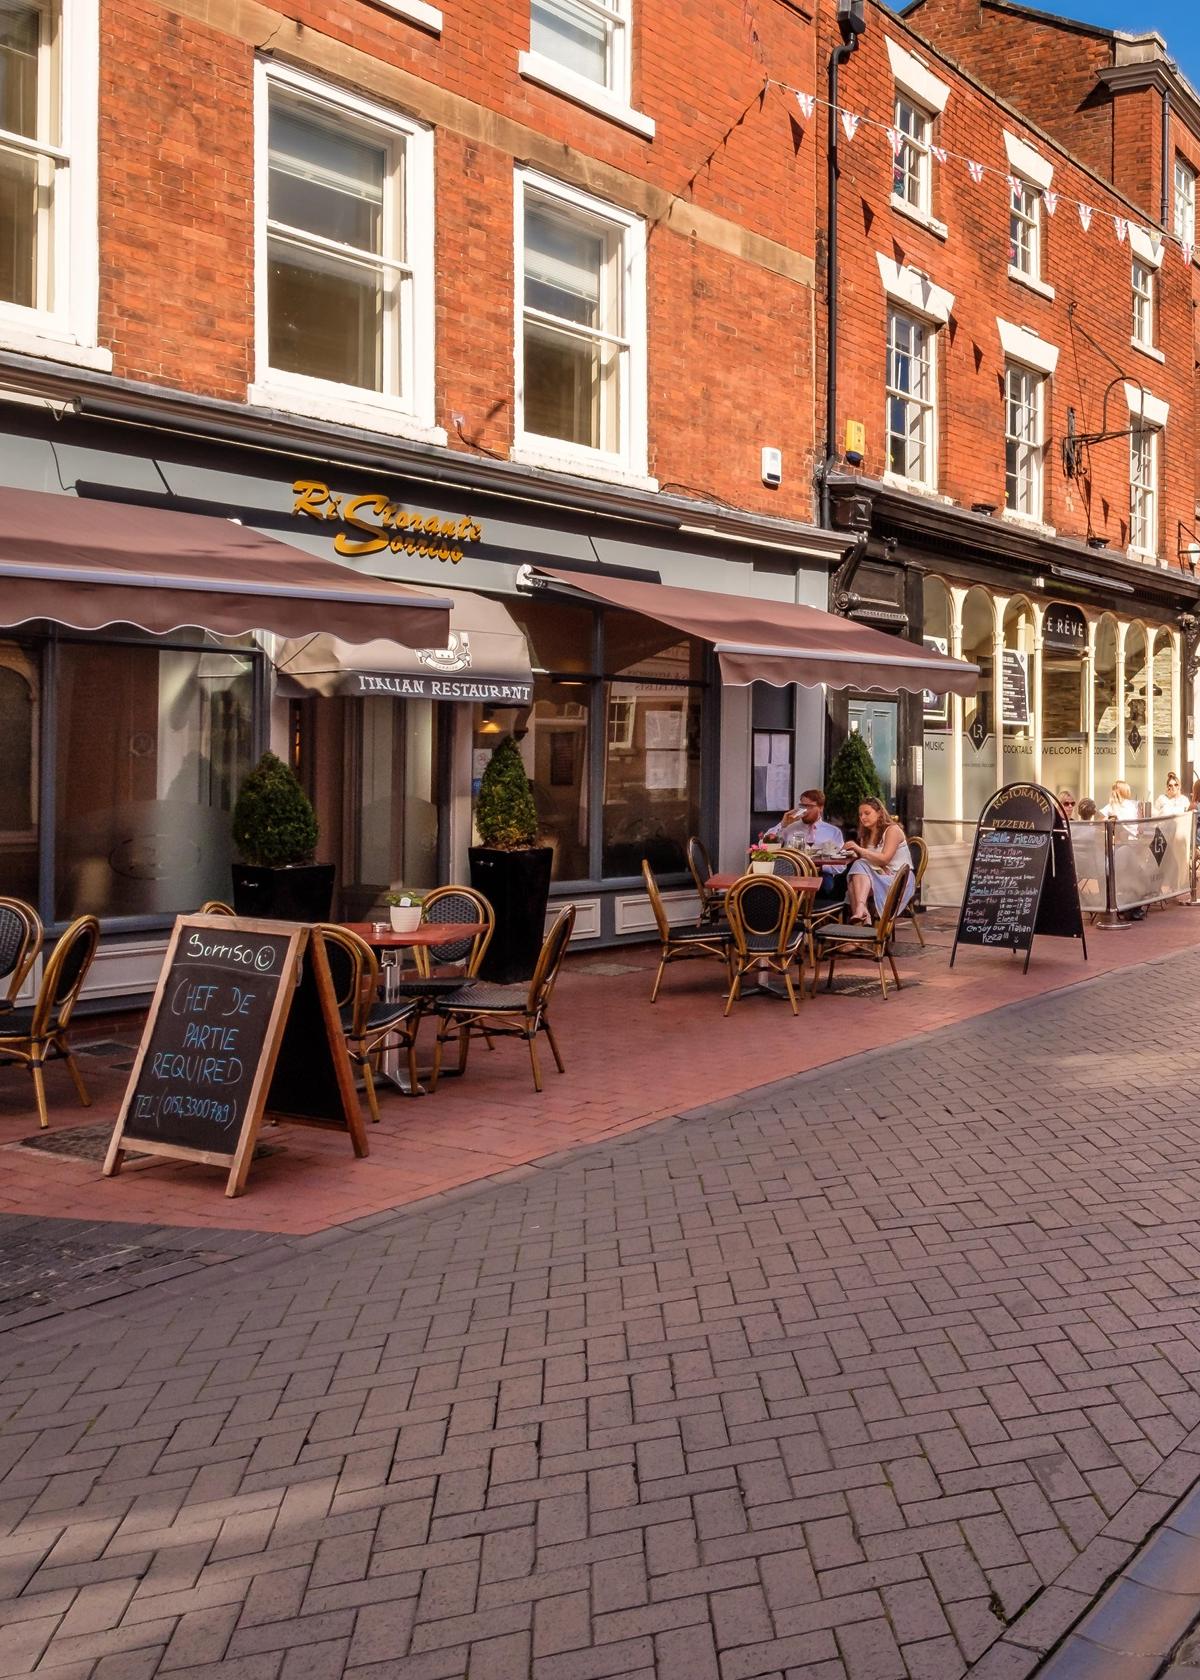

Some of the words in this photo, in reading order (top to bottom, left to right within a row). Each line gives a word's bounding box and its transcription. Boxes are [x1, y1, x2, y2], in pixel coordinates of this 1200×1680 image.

[1042, 617, 1053, 632] E
[358, 675, 425, 694] ITALIAN
[431, 681, 531, 700] RESTAURANT
[924, 741, 945, 751] MUSIC
[1003, 744, 1033, 754] COCKTAILS
[1042, 746, 1083, 755] WELCOME
[992, 787, 1050, 815] RISTORANTE
[992, 819, 1035, 830] PIZZERIA
[187, 933, 254, 964] Sorriso
[171, 977, 219, 1016] CHEF
[222, 986, 256, 1016] DE
[182, 1023, 240, 1050] PARTIE
[152, 1052, 243, 1085] REQUIRED
